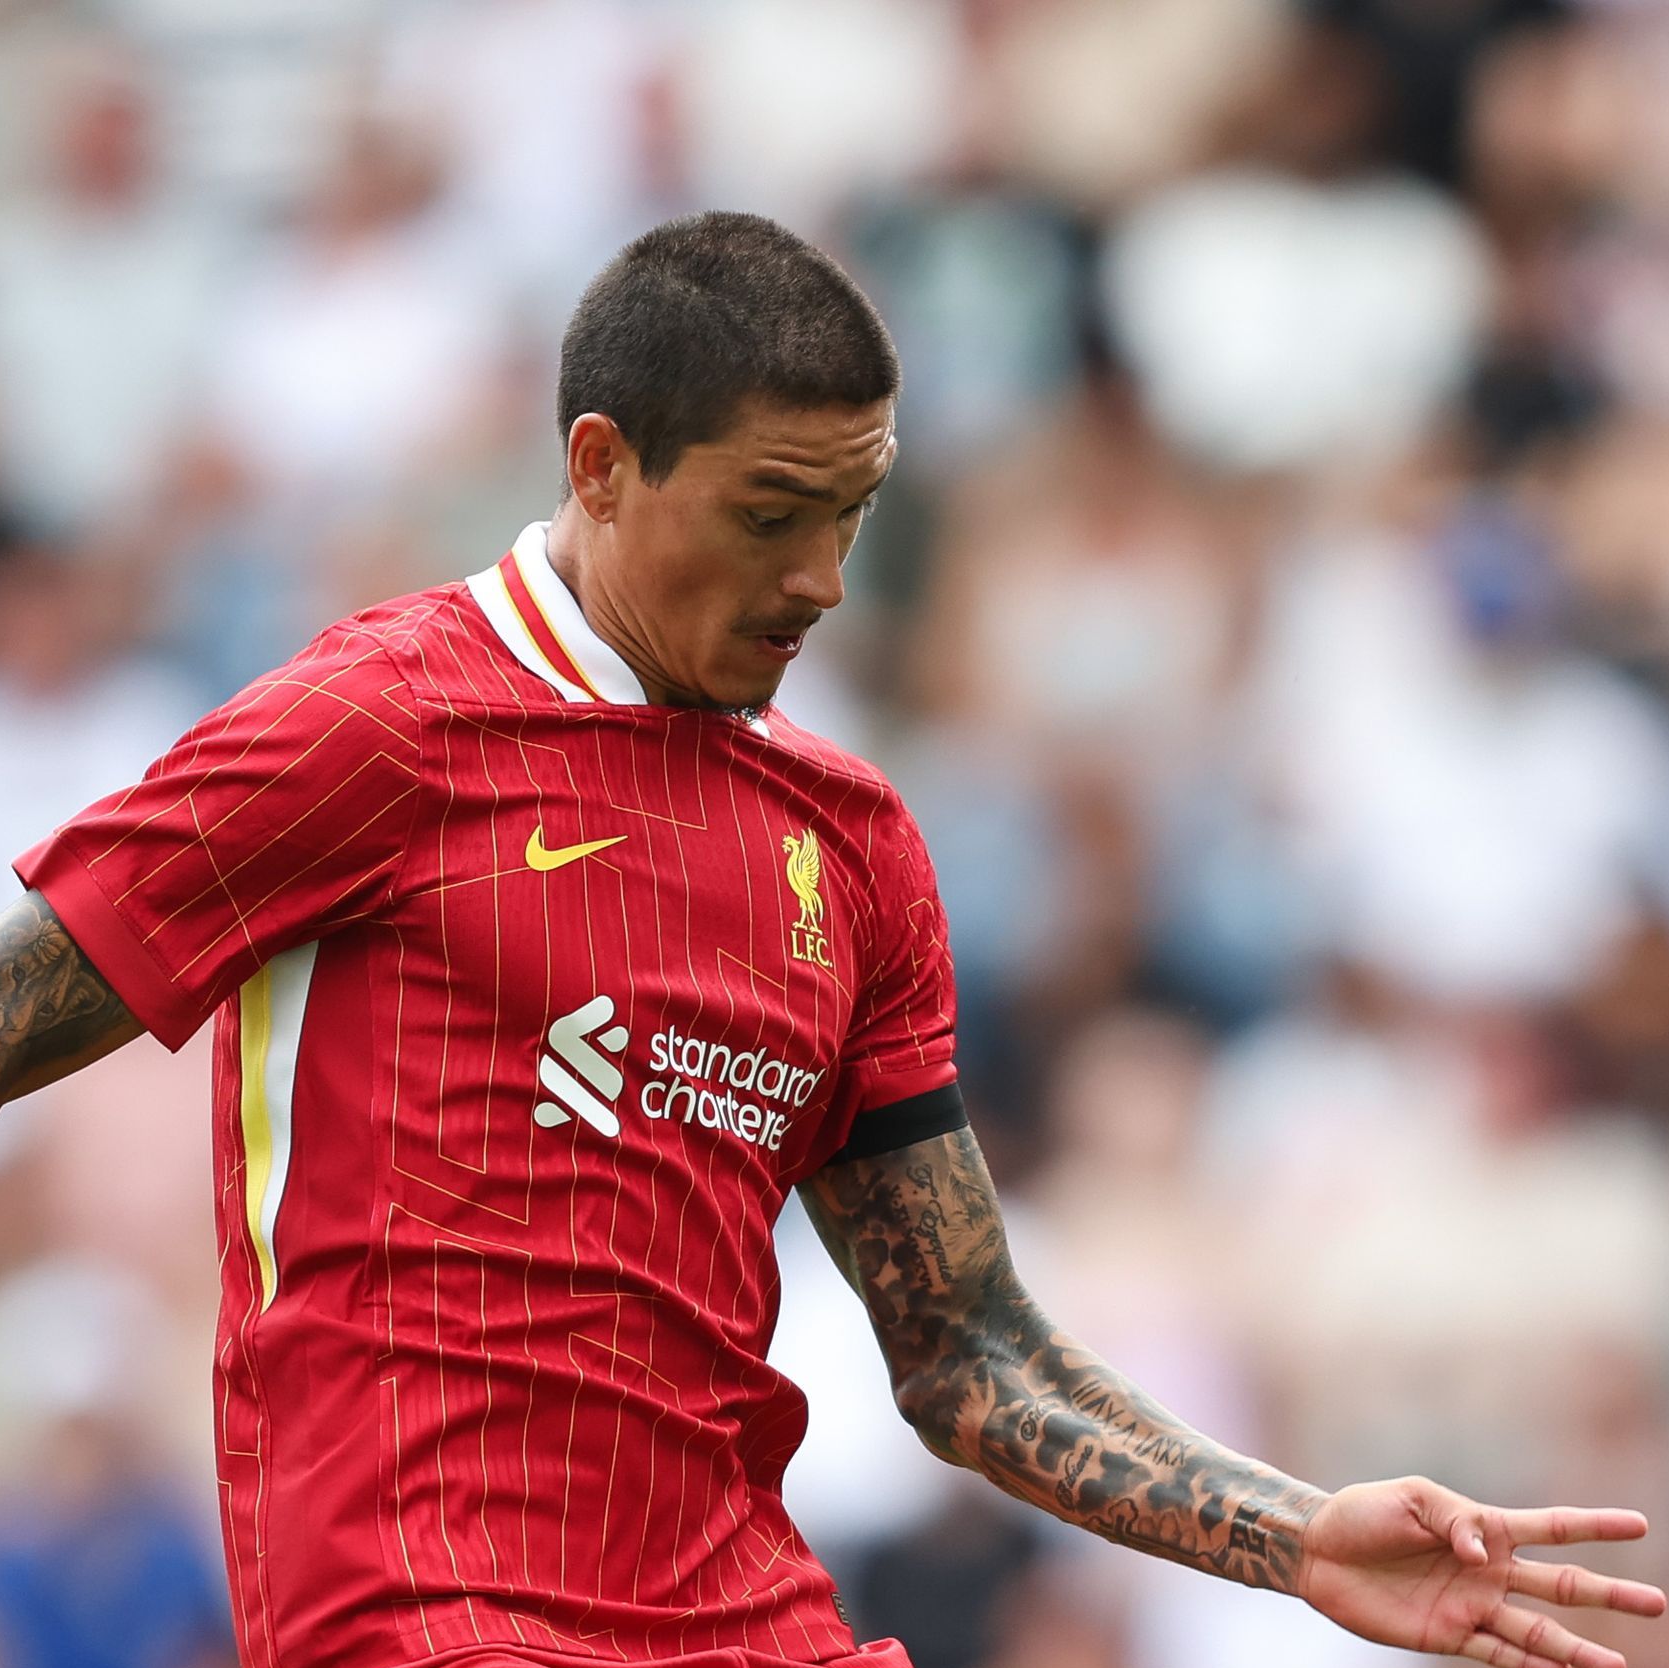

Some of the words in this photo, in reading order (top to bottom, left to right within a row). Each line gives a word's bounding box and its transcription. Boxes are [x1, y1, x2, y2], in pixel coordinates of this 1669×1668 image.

[791, 930, 832, 968] L.F.C.
[650, 1025, 826, 1107] standard
[641, 1075, 793, 1151] chartere
